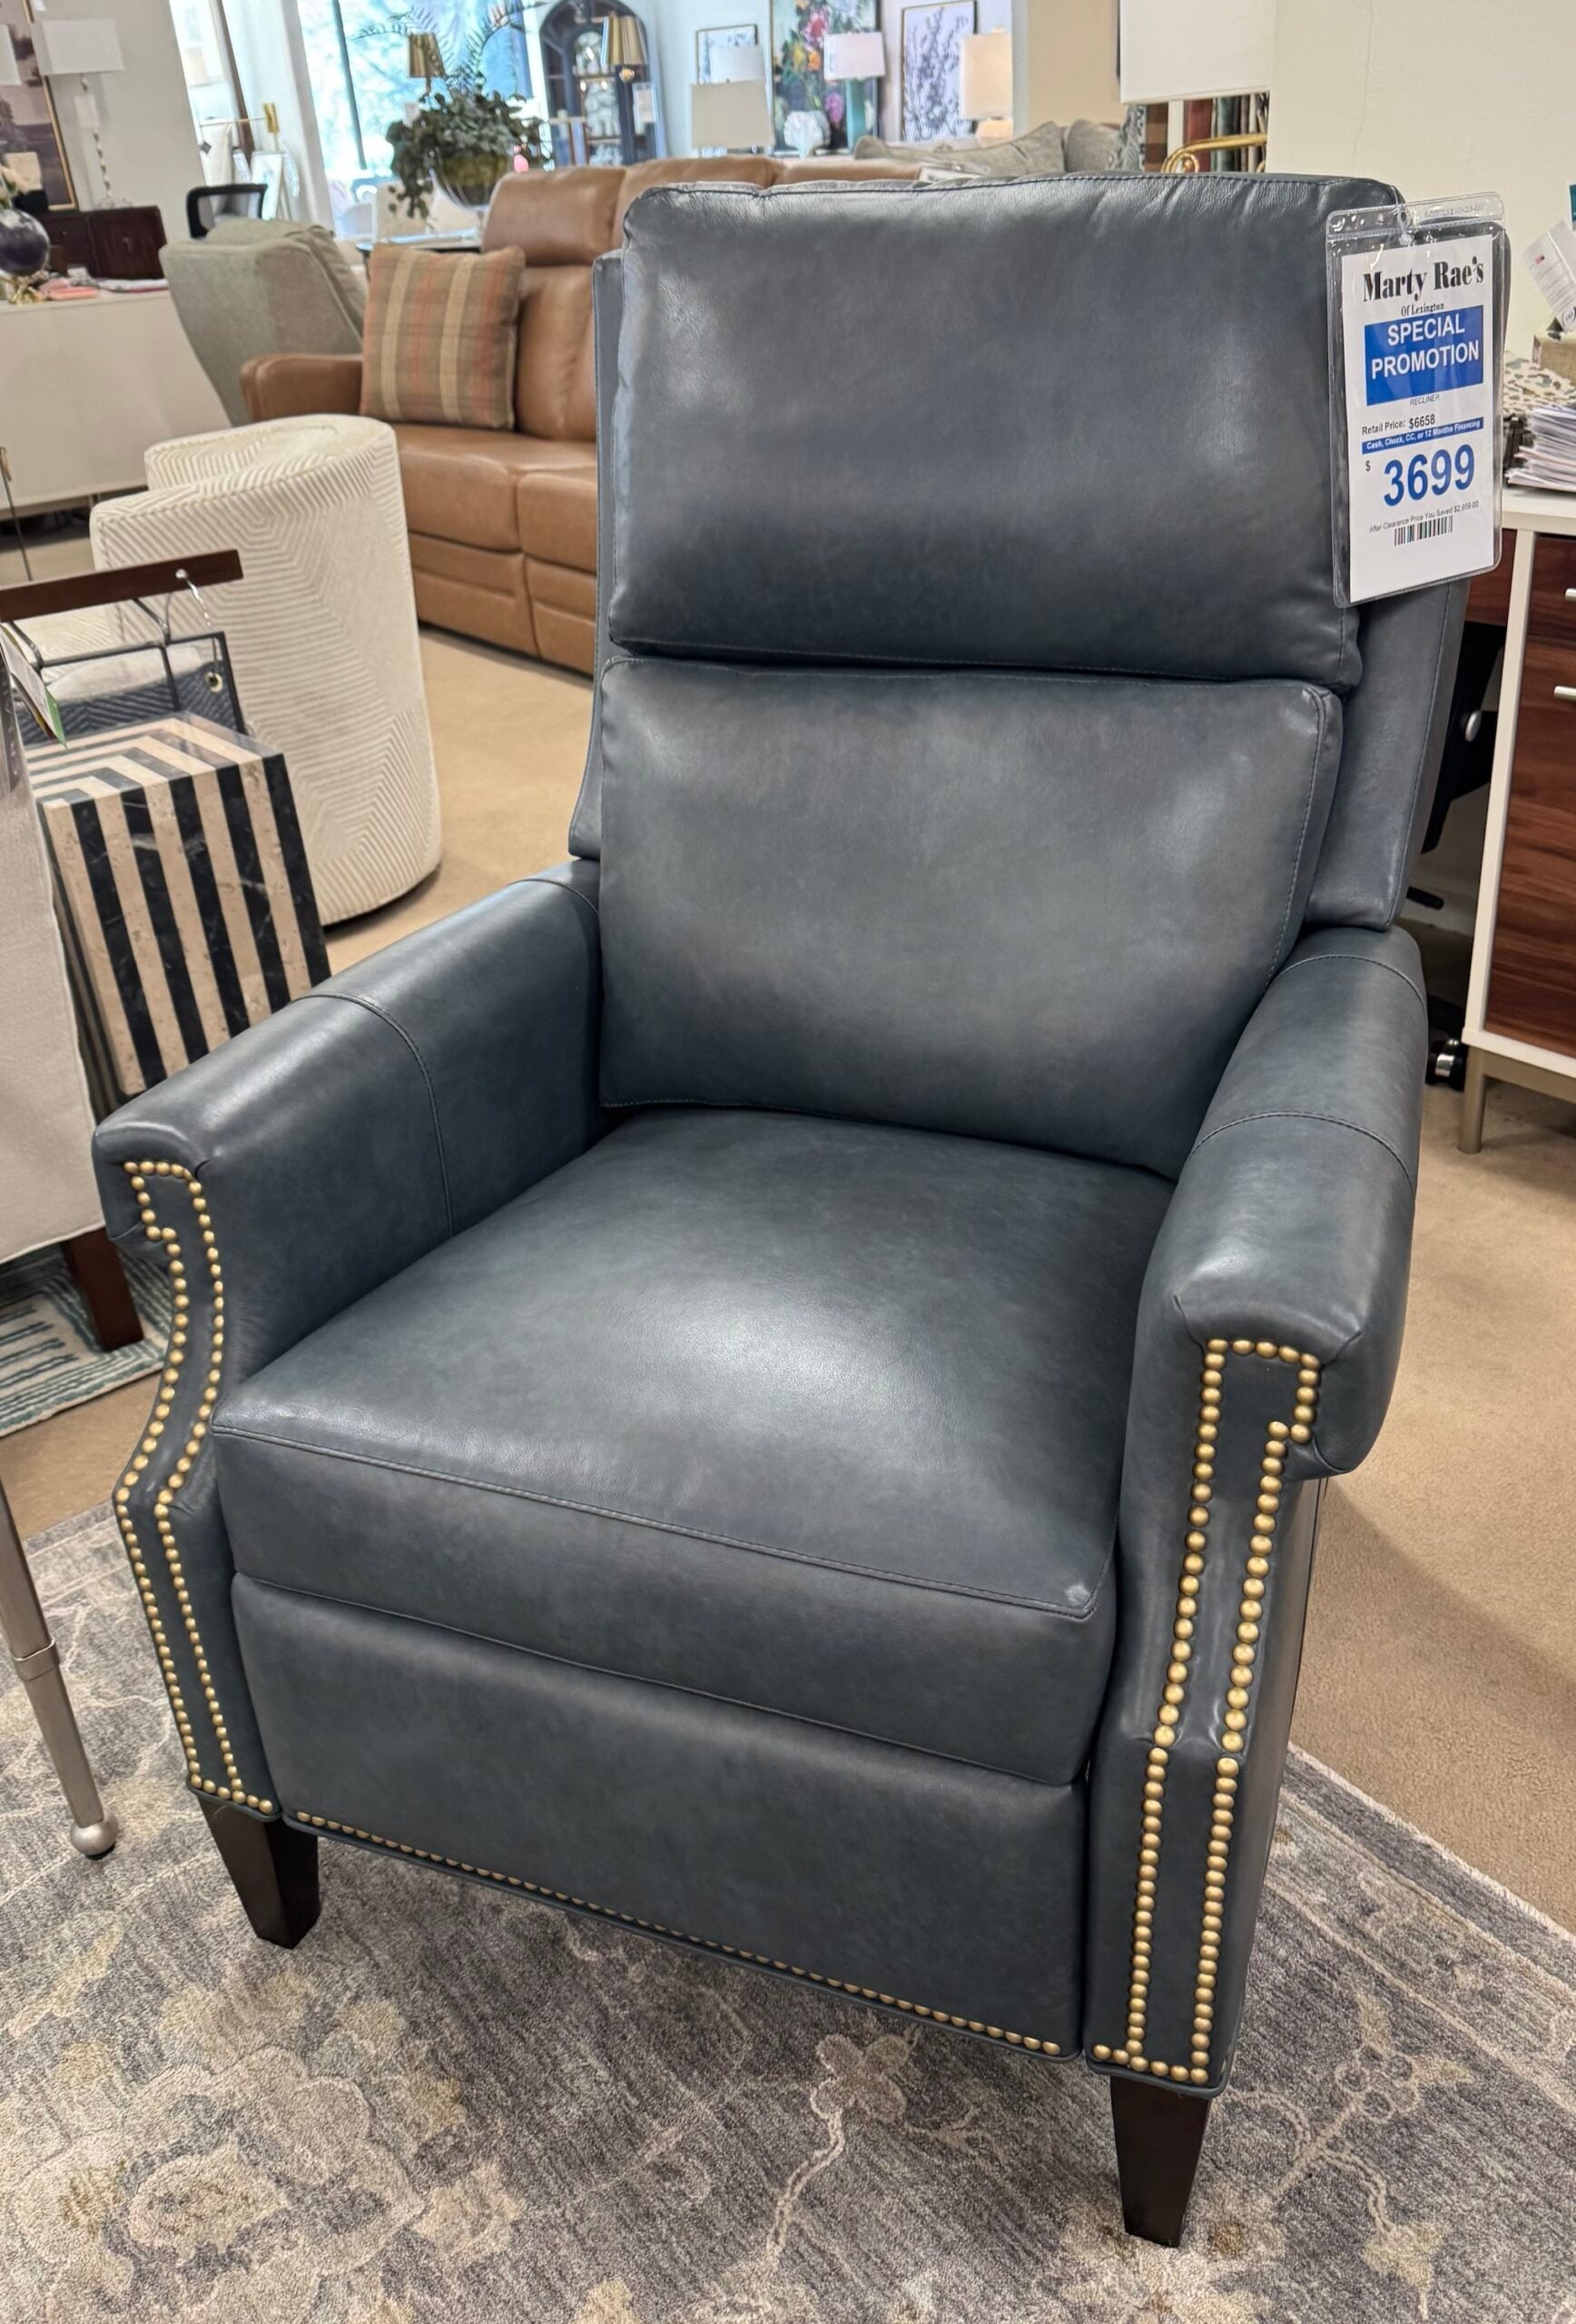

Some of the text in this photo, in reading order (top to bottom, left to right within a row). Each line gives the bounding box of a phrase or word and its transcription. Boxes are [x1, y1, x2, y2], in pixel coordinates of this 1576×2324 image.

[1363, 256, 1484, 301] Marty Rae's
[1401, 302, 1444, 316] Of Lexington
[1387, 314, 1465, 346] SPECIAL
[1371, 340, 1479, 379] PROMOTION
[1410, 394, 1440, 406] RECLINER
[1362, 414, 1435, 435] Retail Price: $6658
[1366, 440, 1384, 450] Cash,
[1405, 433, 1416, 442] CC,
[1433, 426, 1453, 436] Months
[1454, 420, 1481, 431] Financing
[1365, 444, 1475, 507] $ 3699
[1369, 524, 1382, 533] After
[1383, 518, 1409, 529] Clearance
[1436, 507, 1453, 517] Saved
